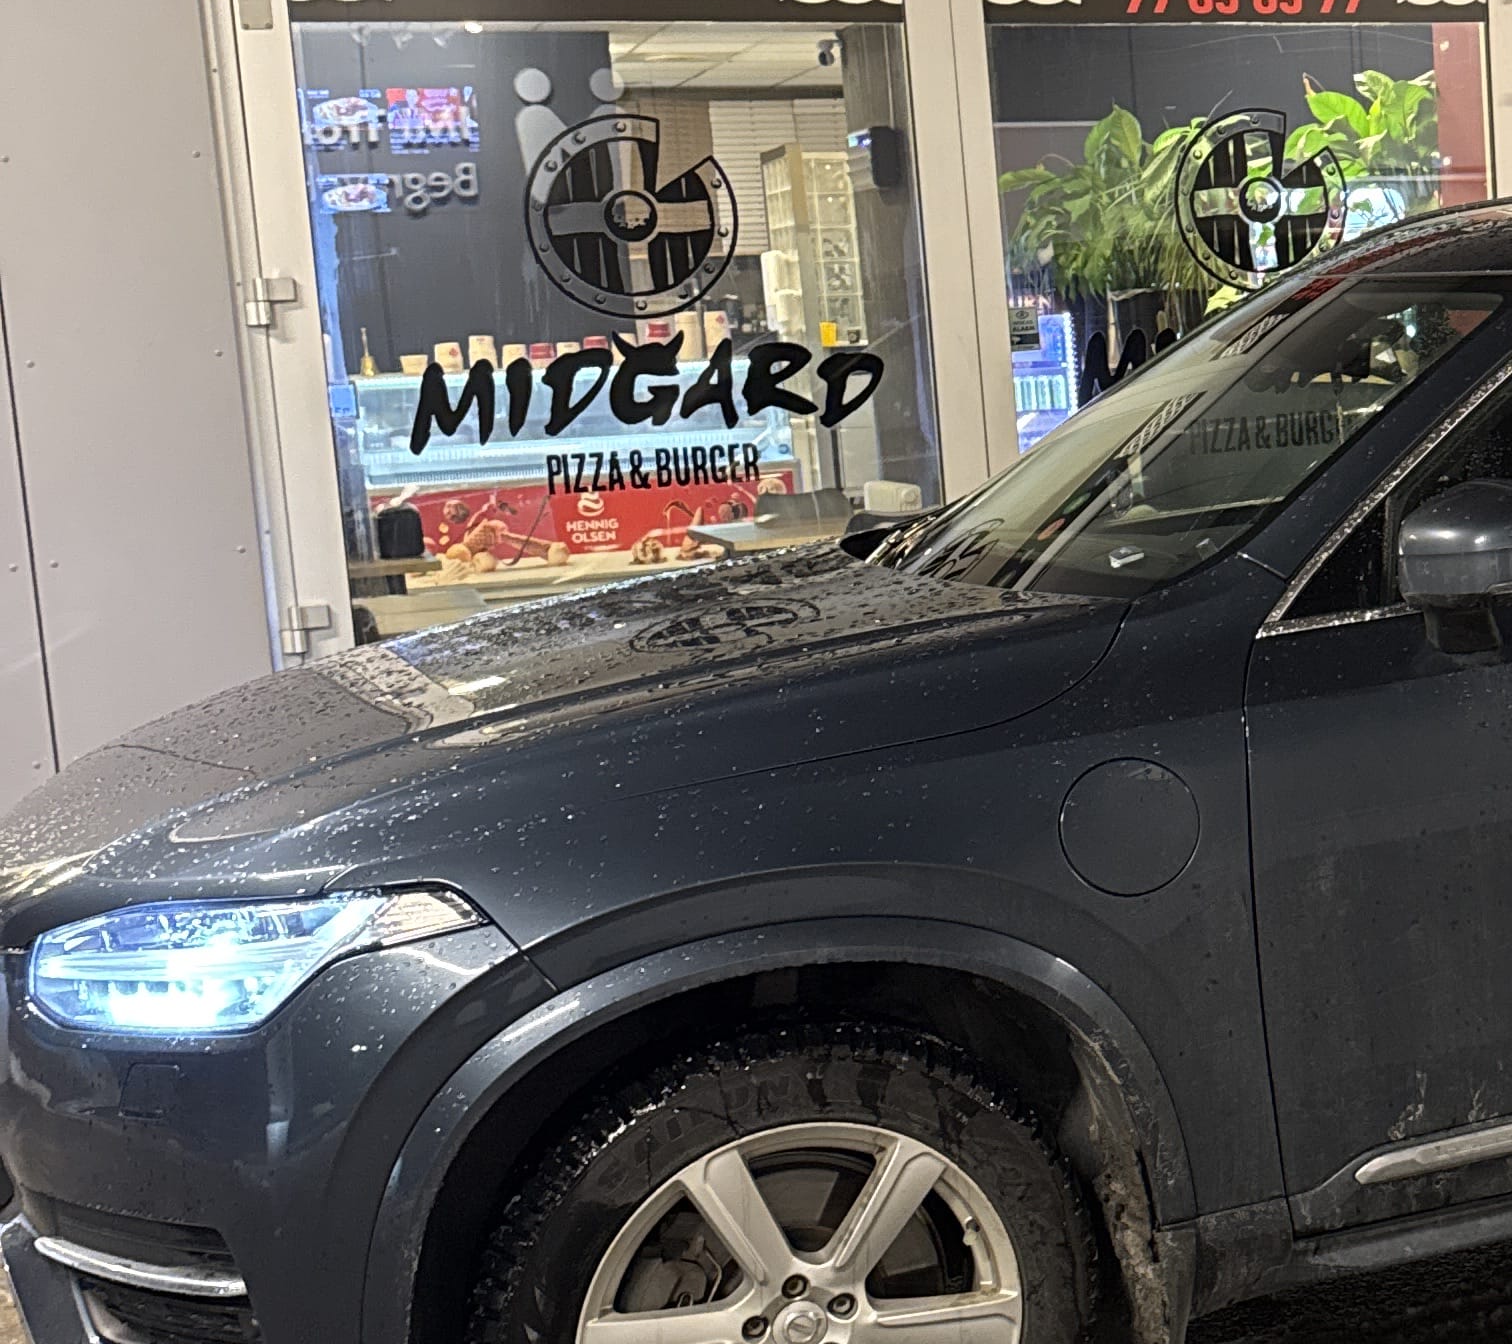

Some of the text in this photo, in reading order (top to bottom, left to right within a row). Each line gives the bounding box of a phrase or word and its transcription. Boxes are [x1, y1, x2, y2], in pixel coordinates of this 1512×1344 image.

[409, 330, 885, 456] MIDGARD
[1275, 409, 1348, 448] BURG
[546, 450, 626, 496] PIZZA
[655, 442, 761, 489] BURGER
[566, 518, 619, 532] HENNIG
[571, 531, 617, 544] OLSEN
